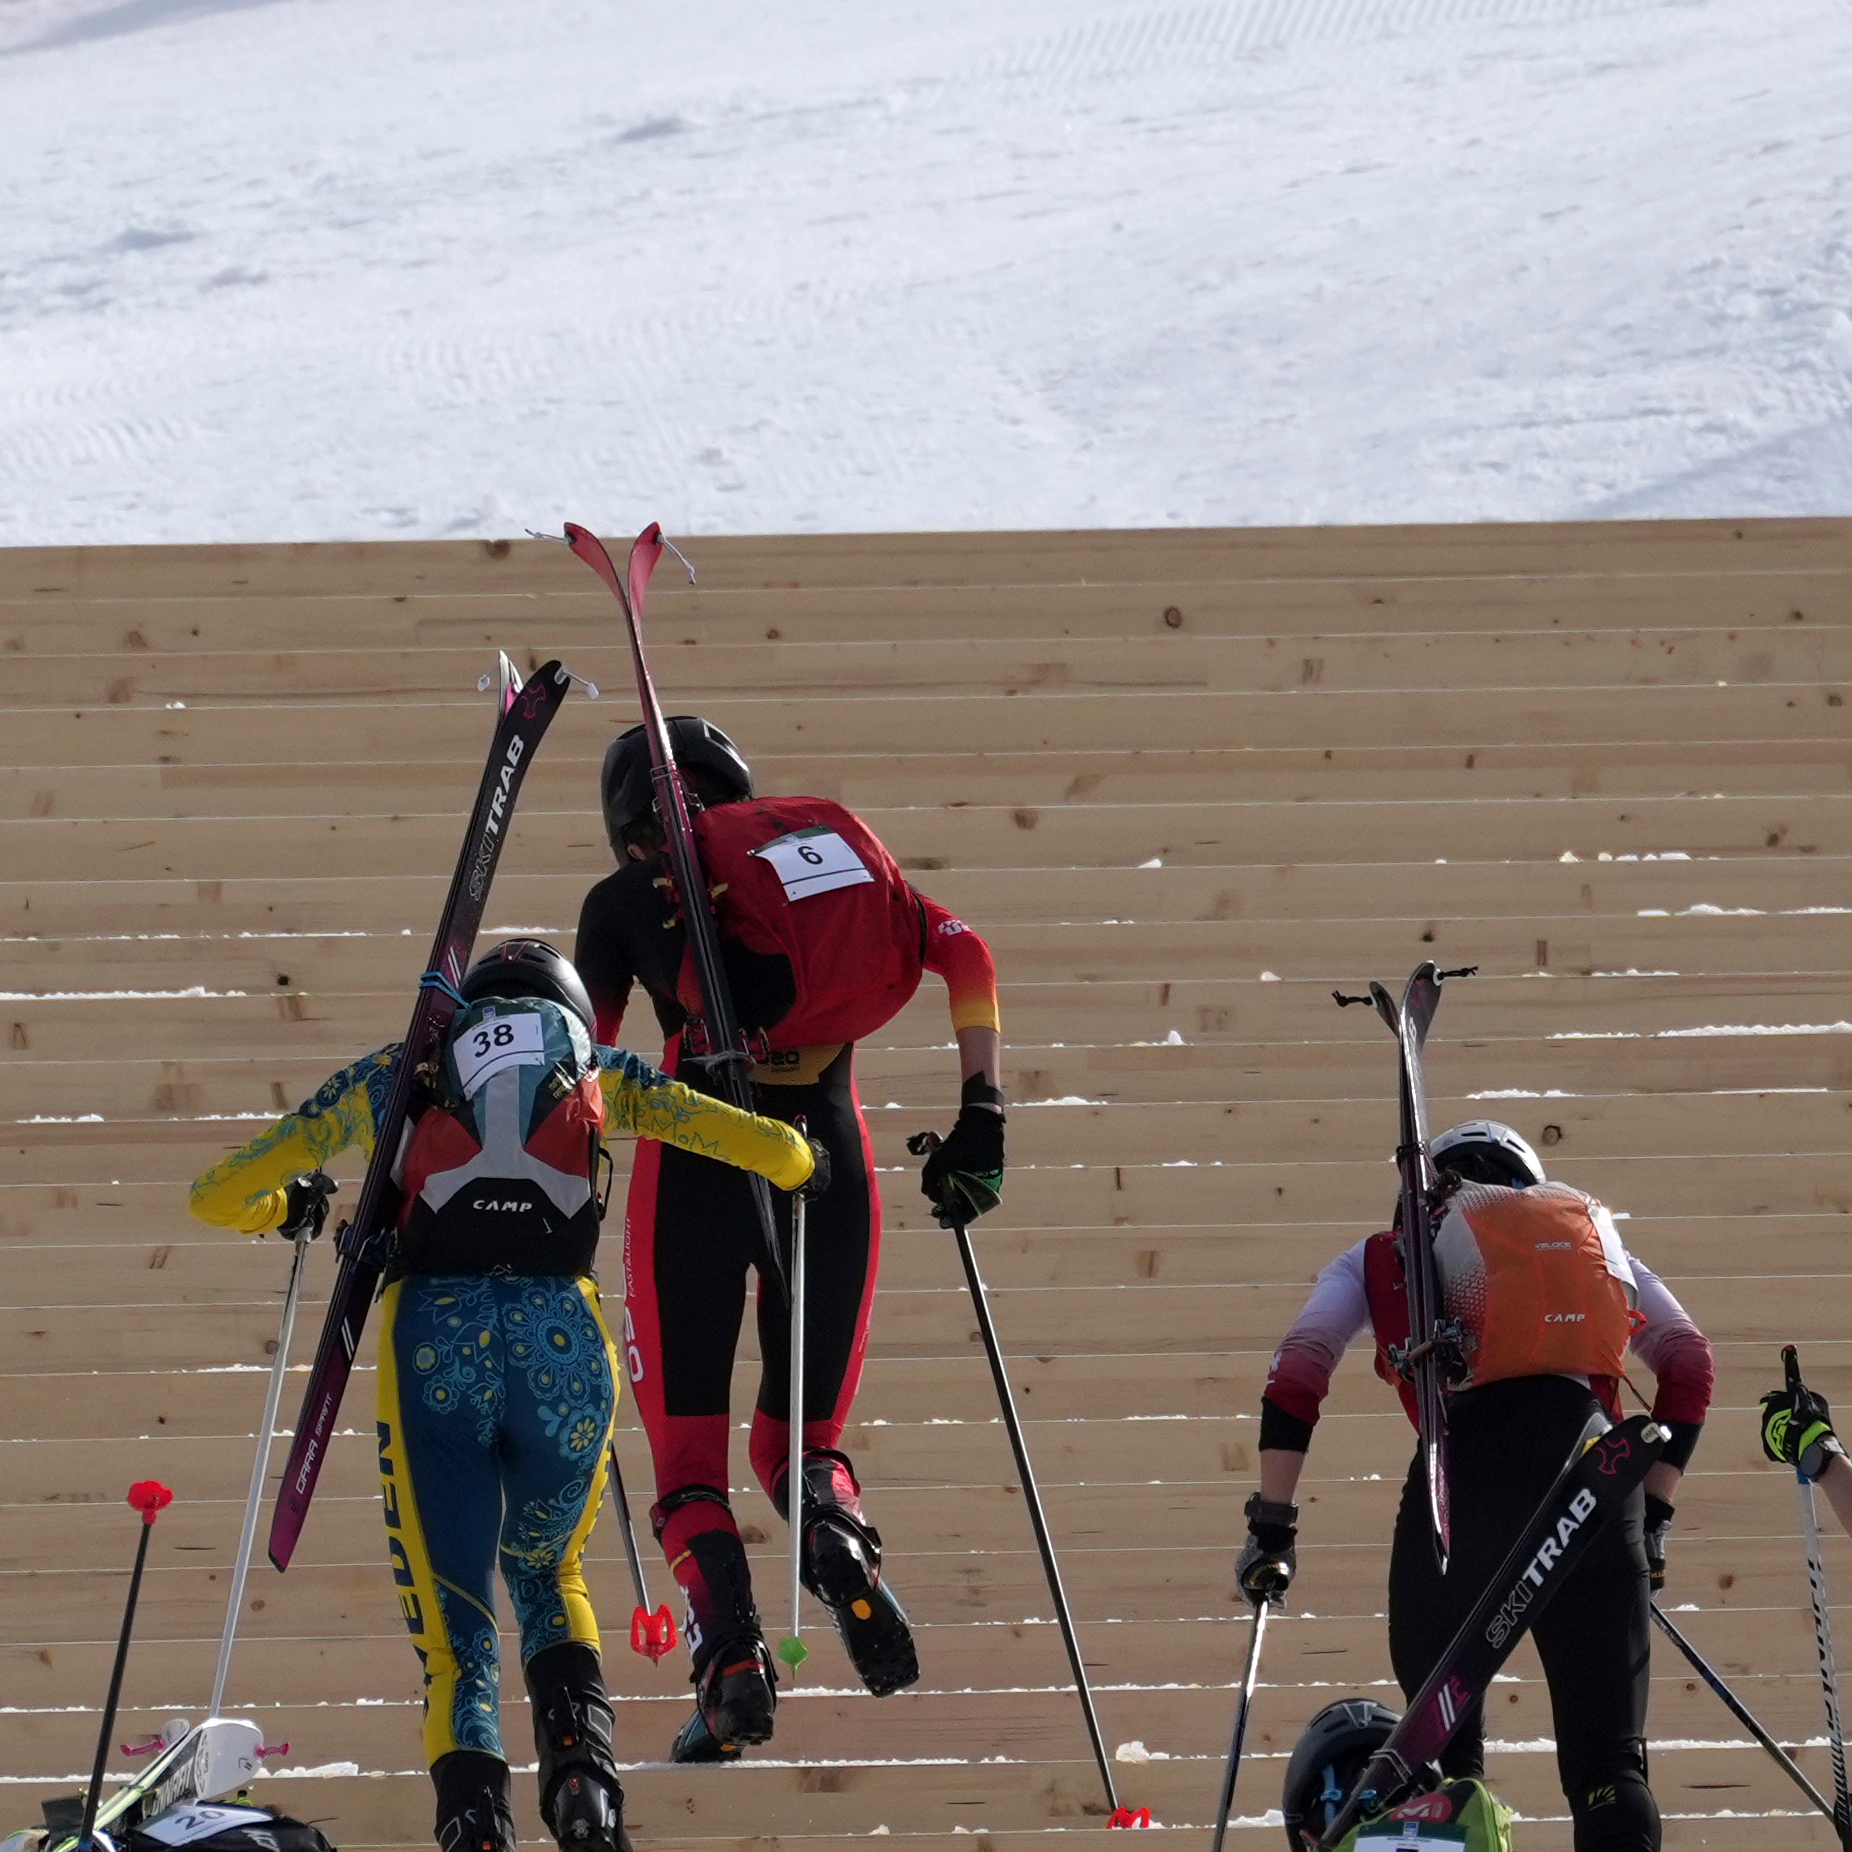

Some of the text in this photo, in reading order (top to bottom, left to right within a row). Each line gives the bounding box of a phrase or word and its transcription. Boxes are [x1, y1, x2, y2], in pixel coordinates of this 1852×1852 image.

[797, 846, 824, 865] 6
[472, 1023, 515, 1058] 38
[472, 1199, 533, 1213] CAMP
[1544, 1313, 1586, 1323] CAMP
[175, 1810, 225, 1831] 20
